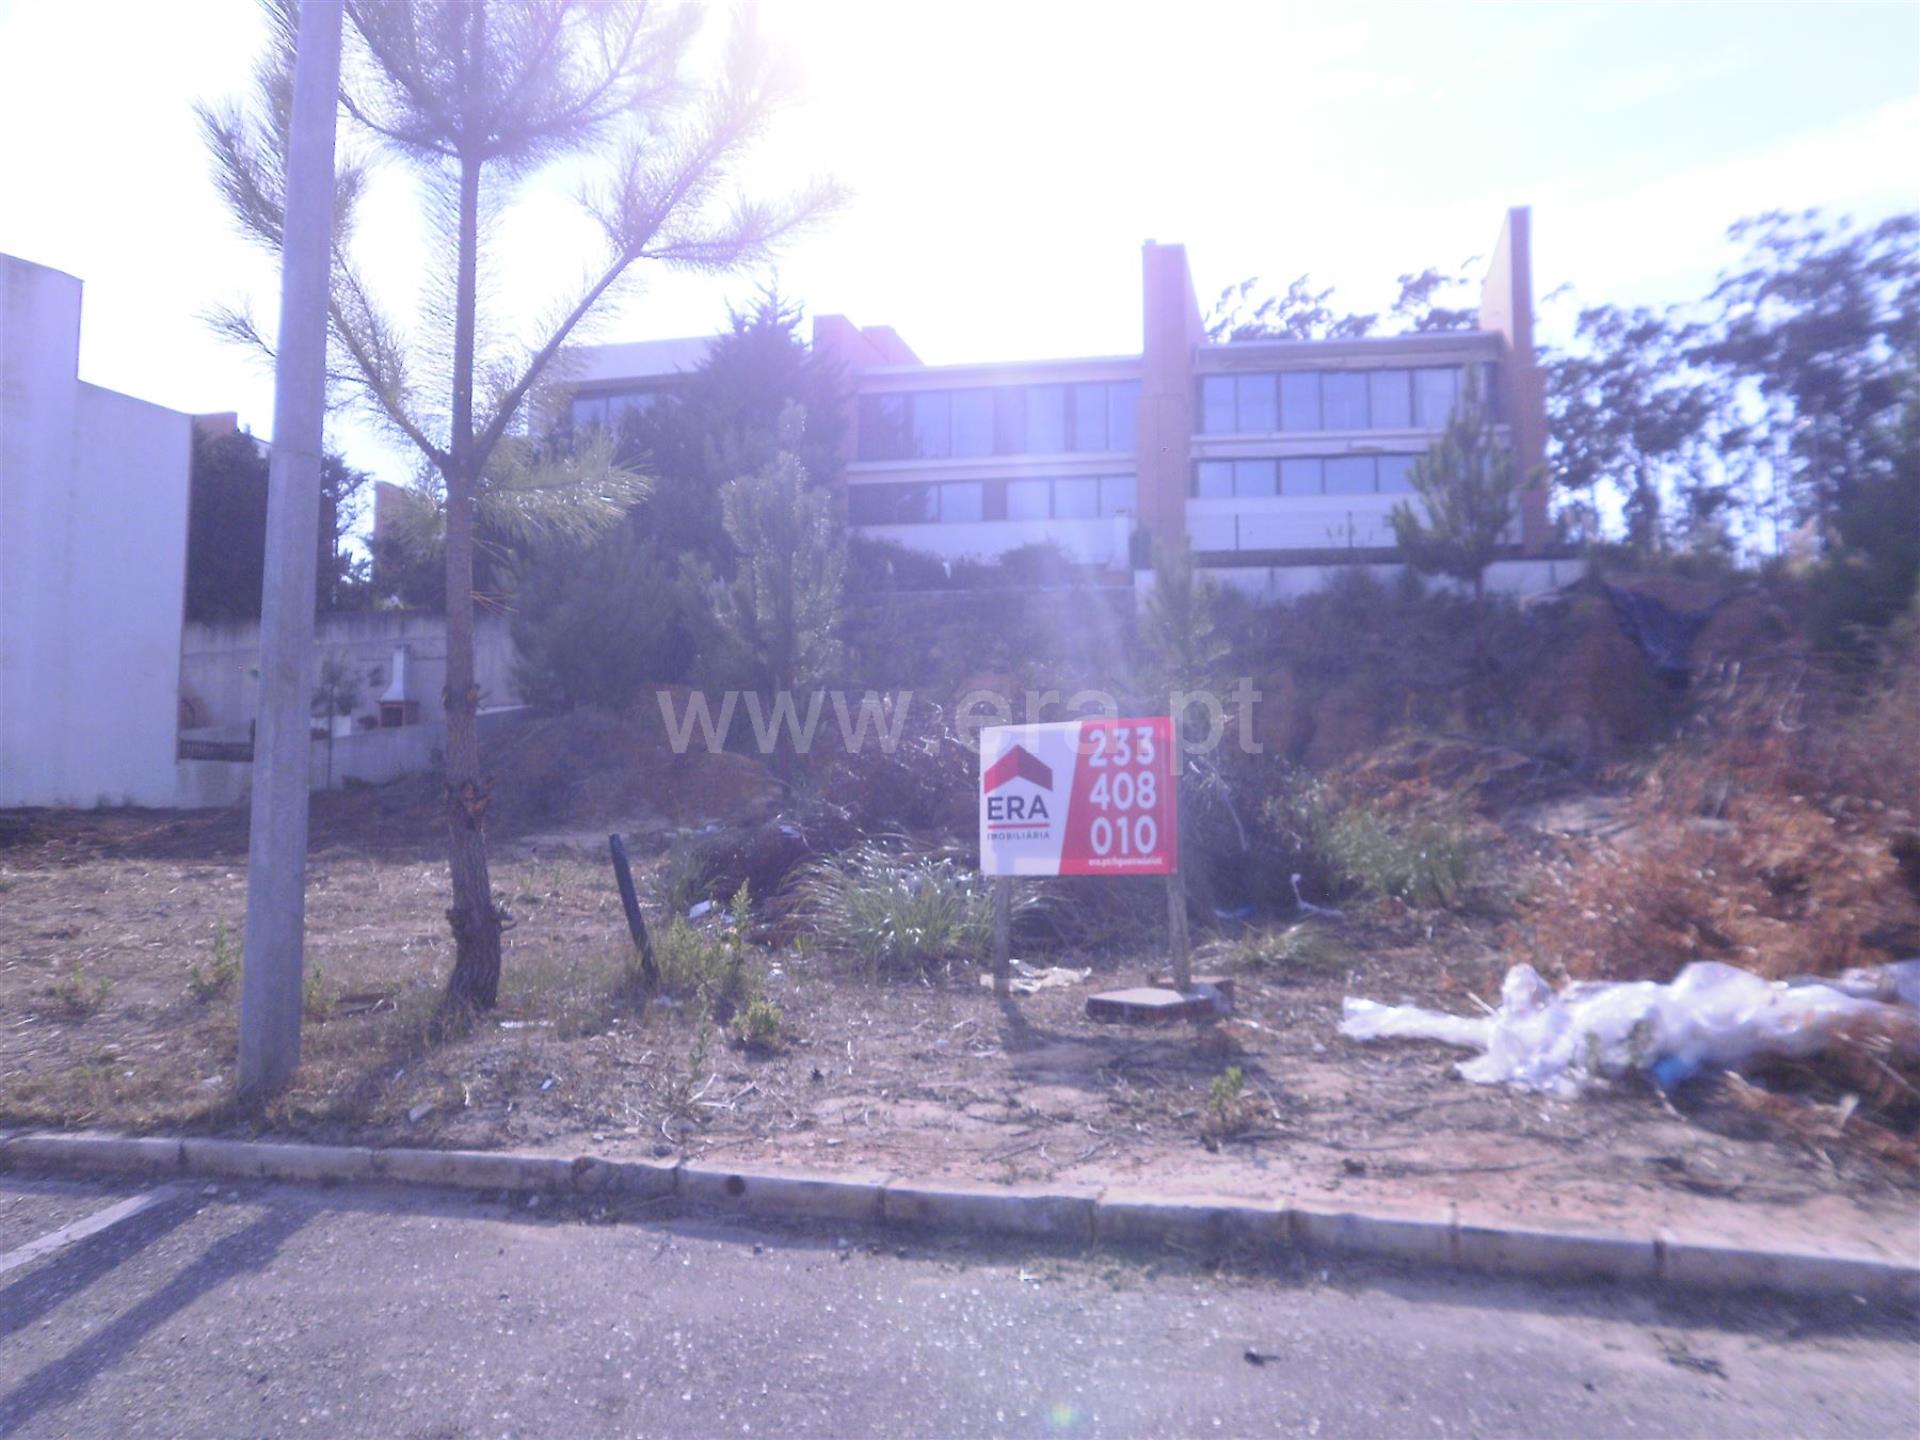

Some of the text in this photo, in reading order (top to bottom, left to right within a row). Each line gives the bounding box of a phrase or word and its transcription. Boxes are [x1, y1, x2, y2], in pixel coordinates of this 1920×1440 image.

[1089, 726, 1154, 768] 233
[987, 794, 1049, 820] ERA
[1089, 771, 1157, 811] 408
[1090, 815, 1157, 855] 010
